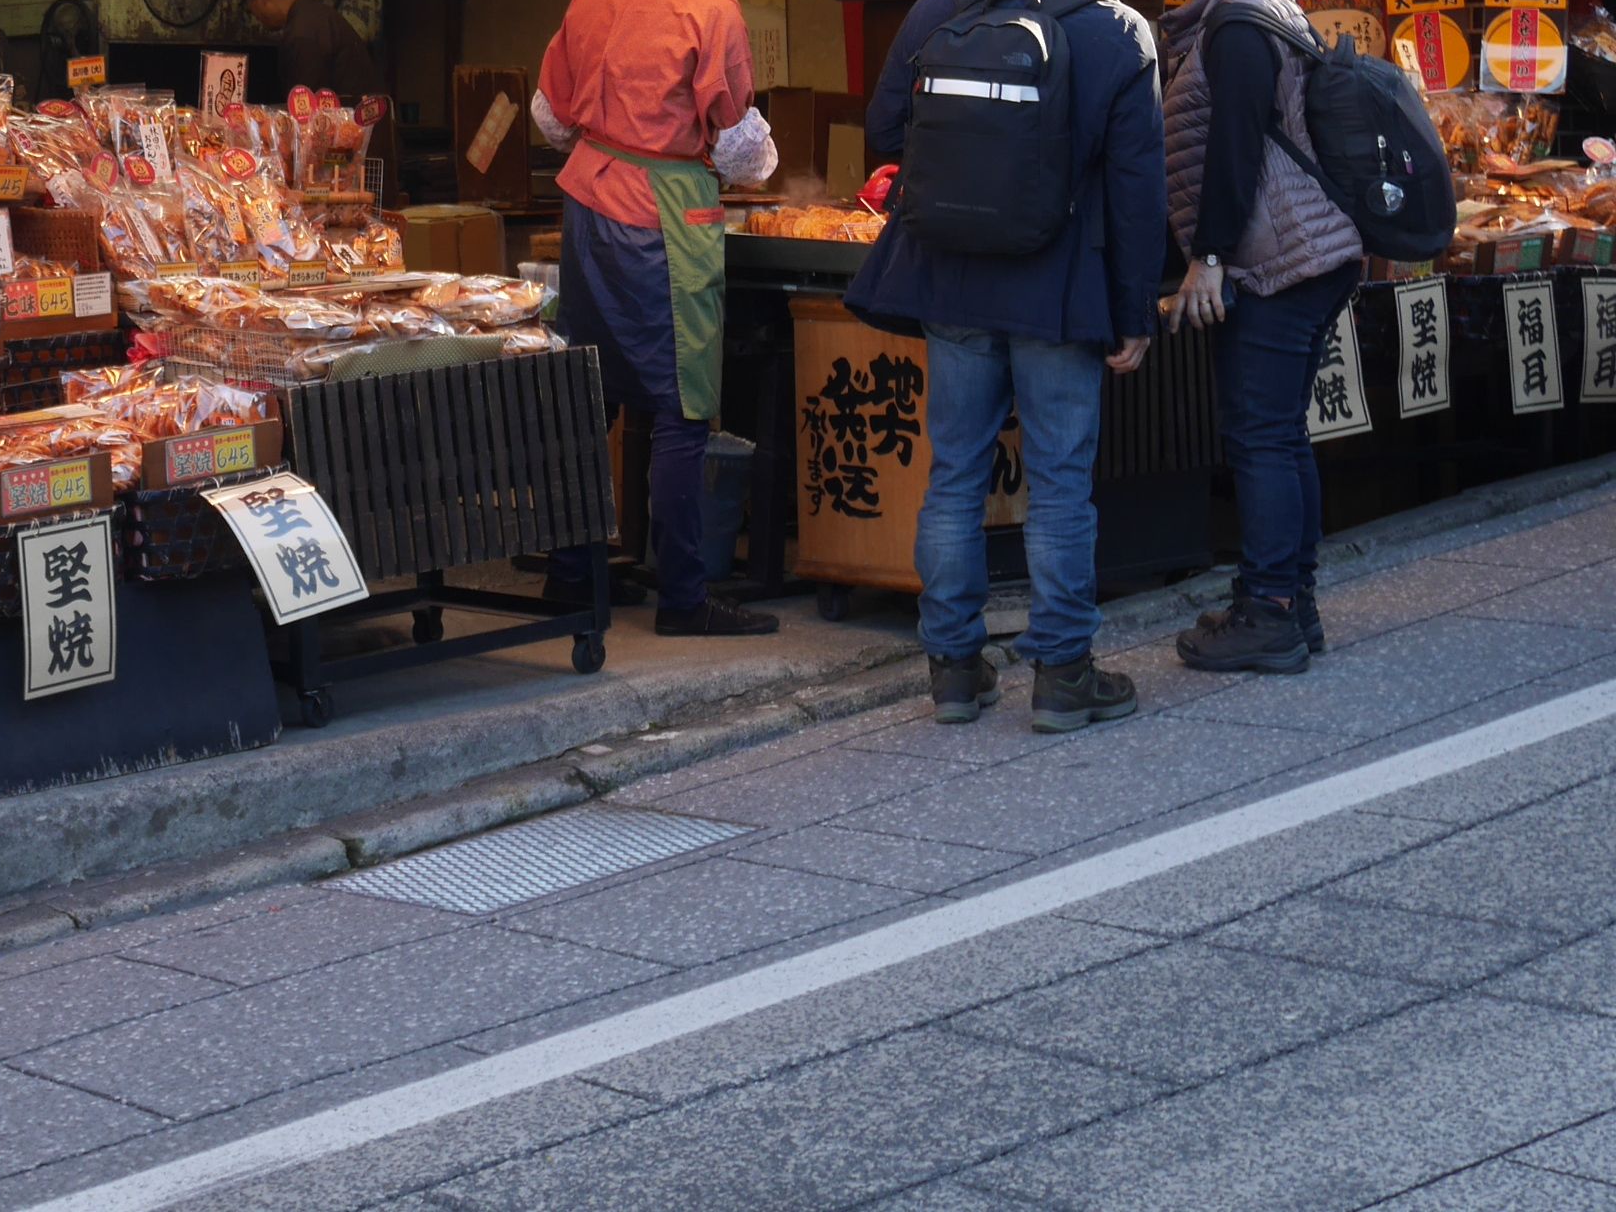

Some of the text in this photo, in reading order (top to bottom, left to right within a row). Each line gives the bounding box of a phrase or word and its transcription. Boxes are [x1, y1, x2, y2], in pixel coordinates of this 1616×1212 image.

[39, 293, 69, 311] 645
[1410, 298, 1438, 401] 堅焼
[1518, 298, 1549, 398] 福耳
[174, 444, 250, 477] 堅焼 645
[801, 395, 828, 516] 承ります
[869, 353, 924, 468] 地方
[9, 477, 85, 510] 堅焼 645
[240, 489, 342, 601] 堅焼
[43, 541, 95, 677] 堅焼
